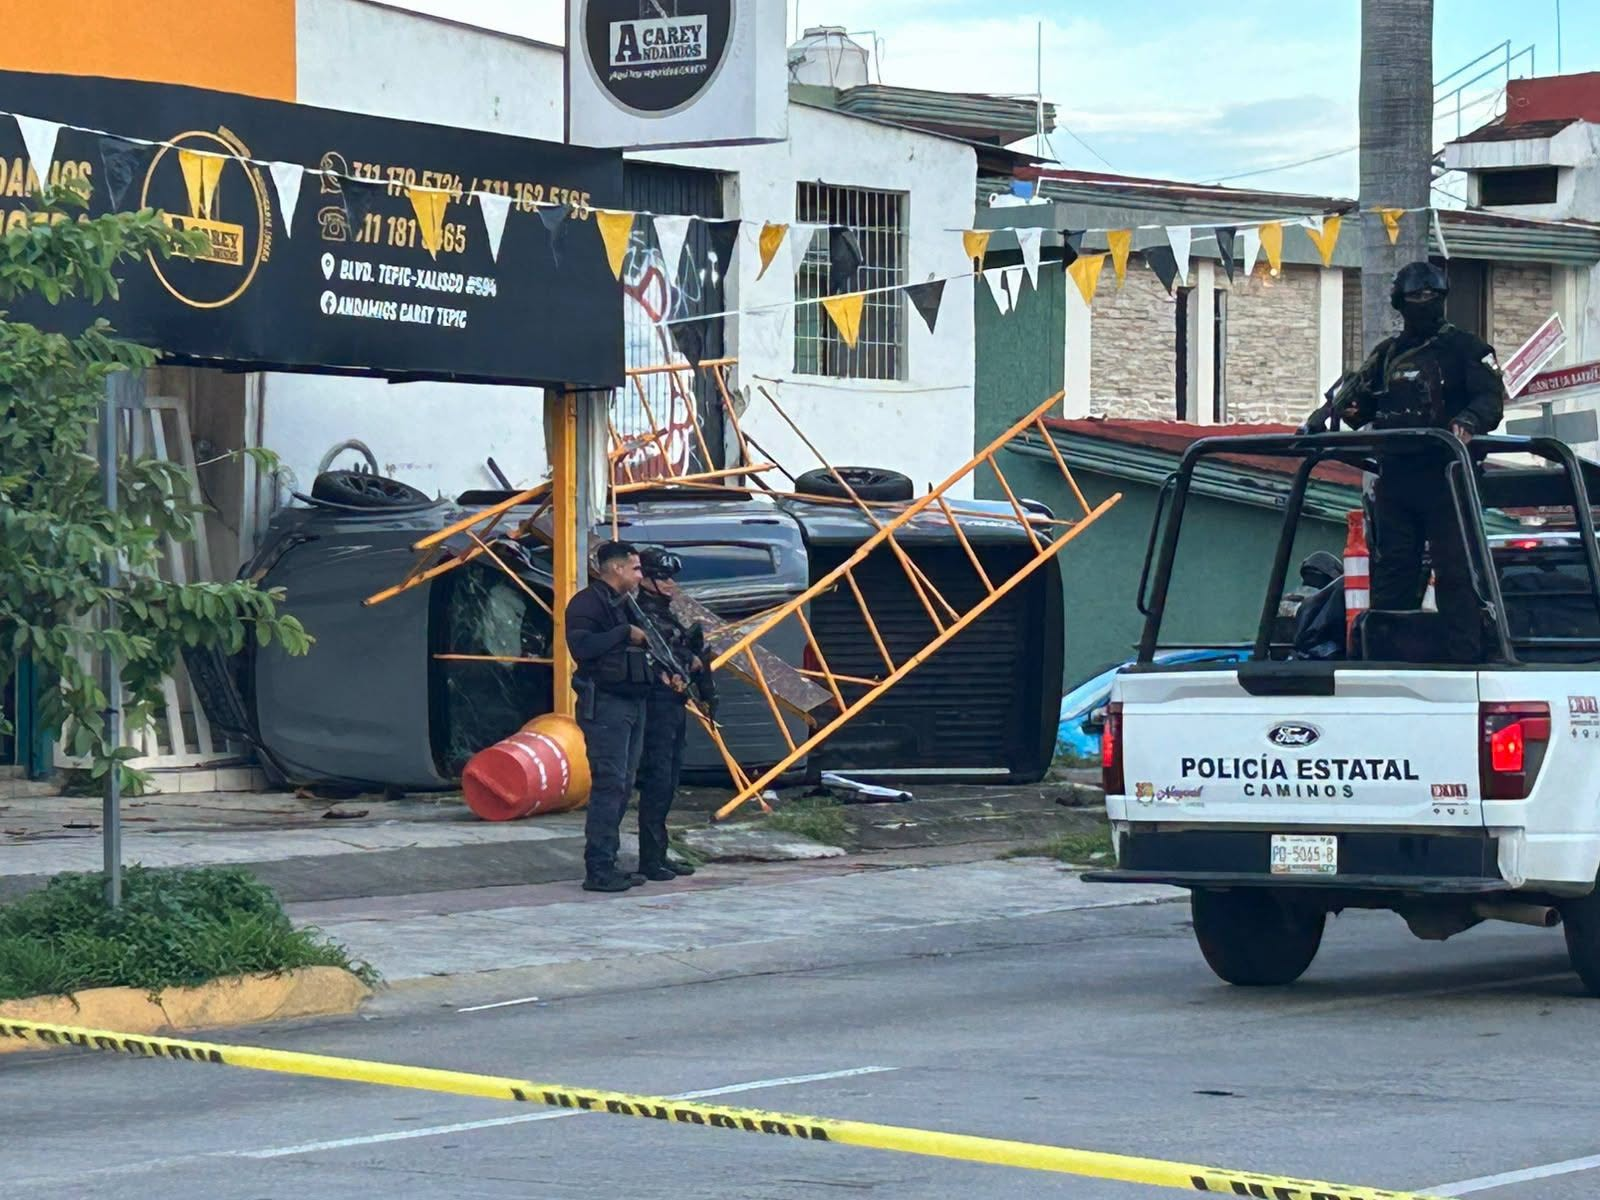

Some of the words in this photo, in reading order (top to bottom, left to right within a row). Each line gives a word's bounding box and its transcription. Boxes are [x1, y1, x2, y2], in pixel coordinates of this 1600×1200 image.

[642, 25, 702, 47] CAREY
[355, 213, 382, 244] 11
[387, 216, 416, 248] 181
[422, 221, 467, 254] 65
[337, 296, 398, 320] ANDAMIOS
[437, 307, 468, 330] TEPIC
[1275, 726, 1311, 744] Ford
[1181, 754, 1288, 780] POLICÍA
[1297, 758, 1419, 781] ESTATAL
[1243, 783, 1354, 799] CAMINOS
